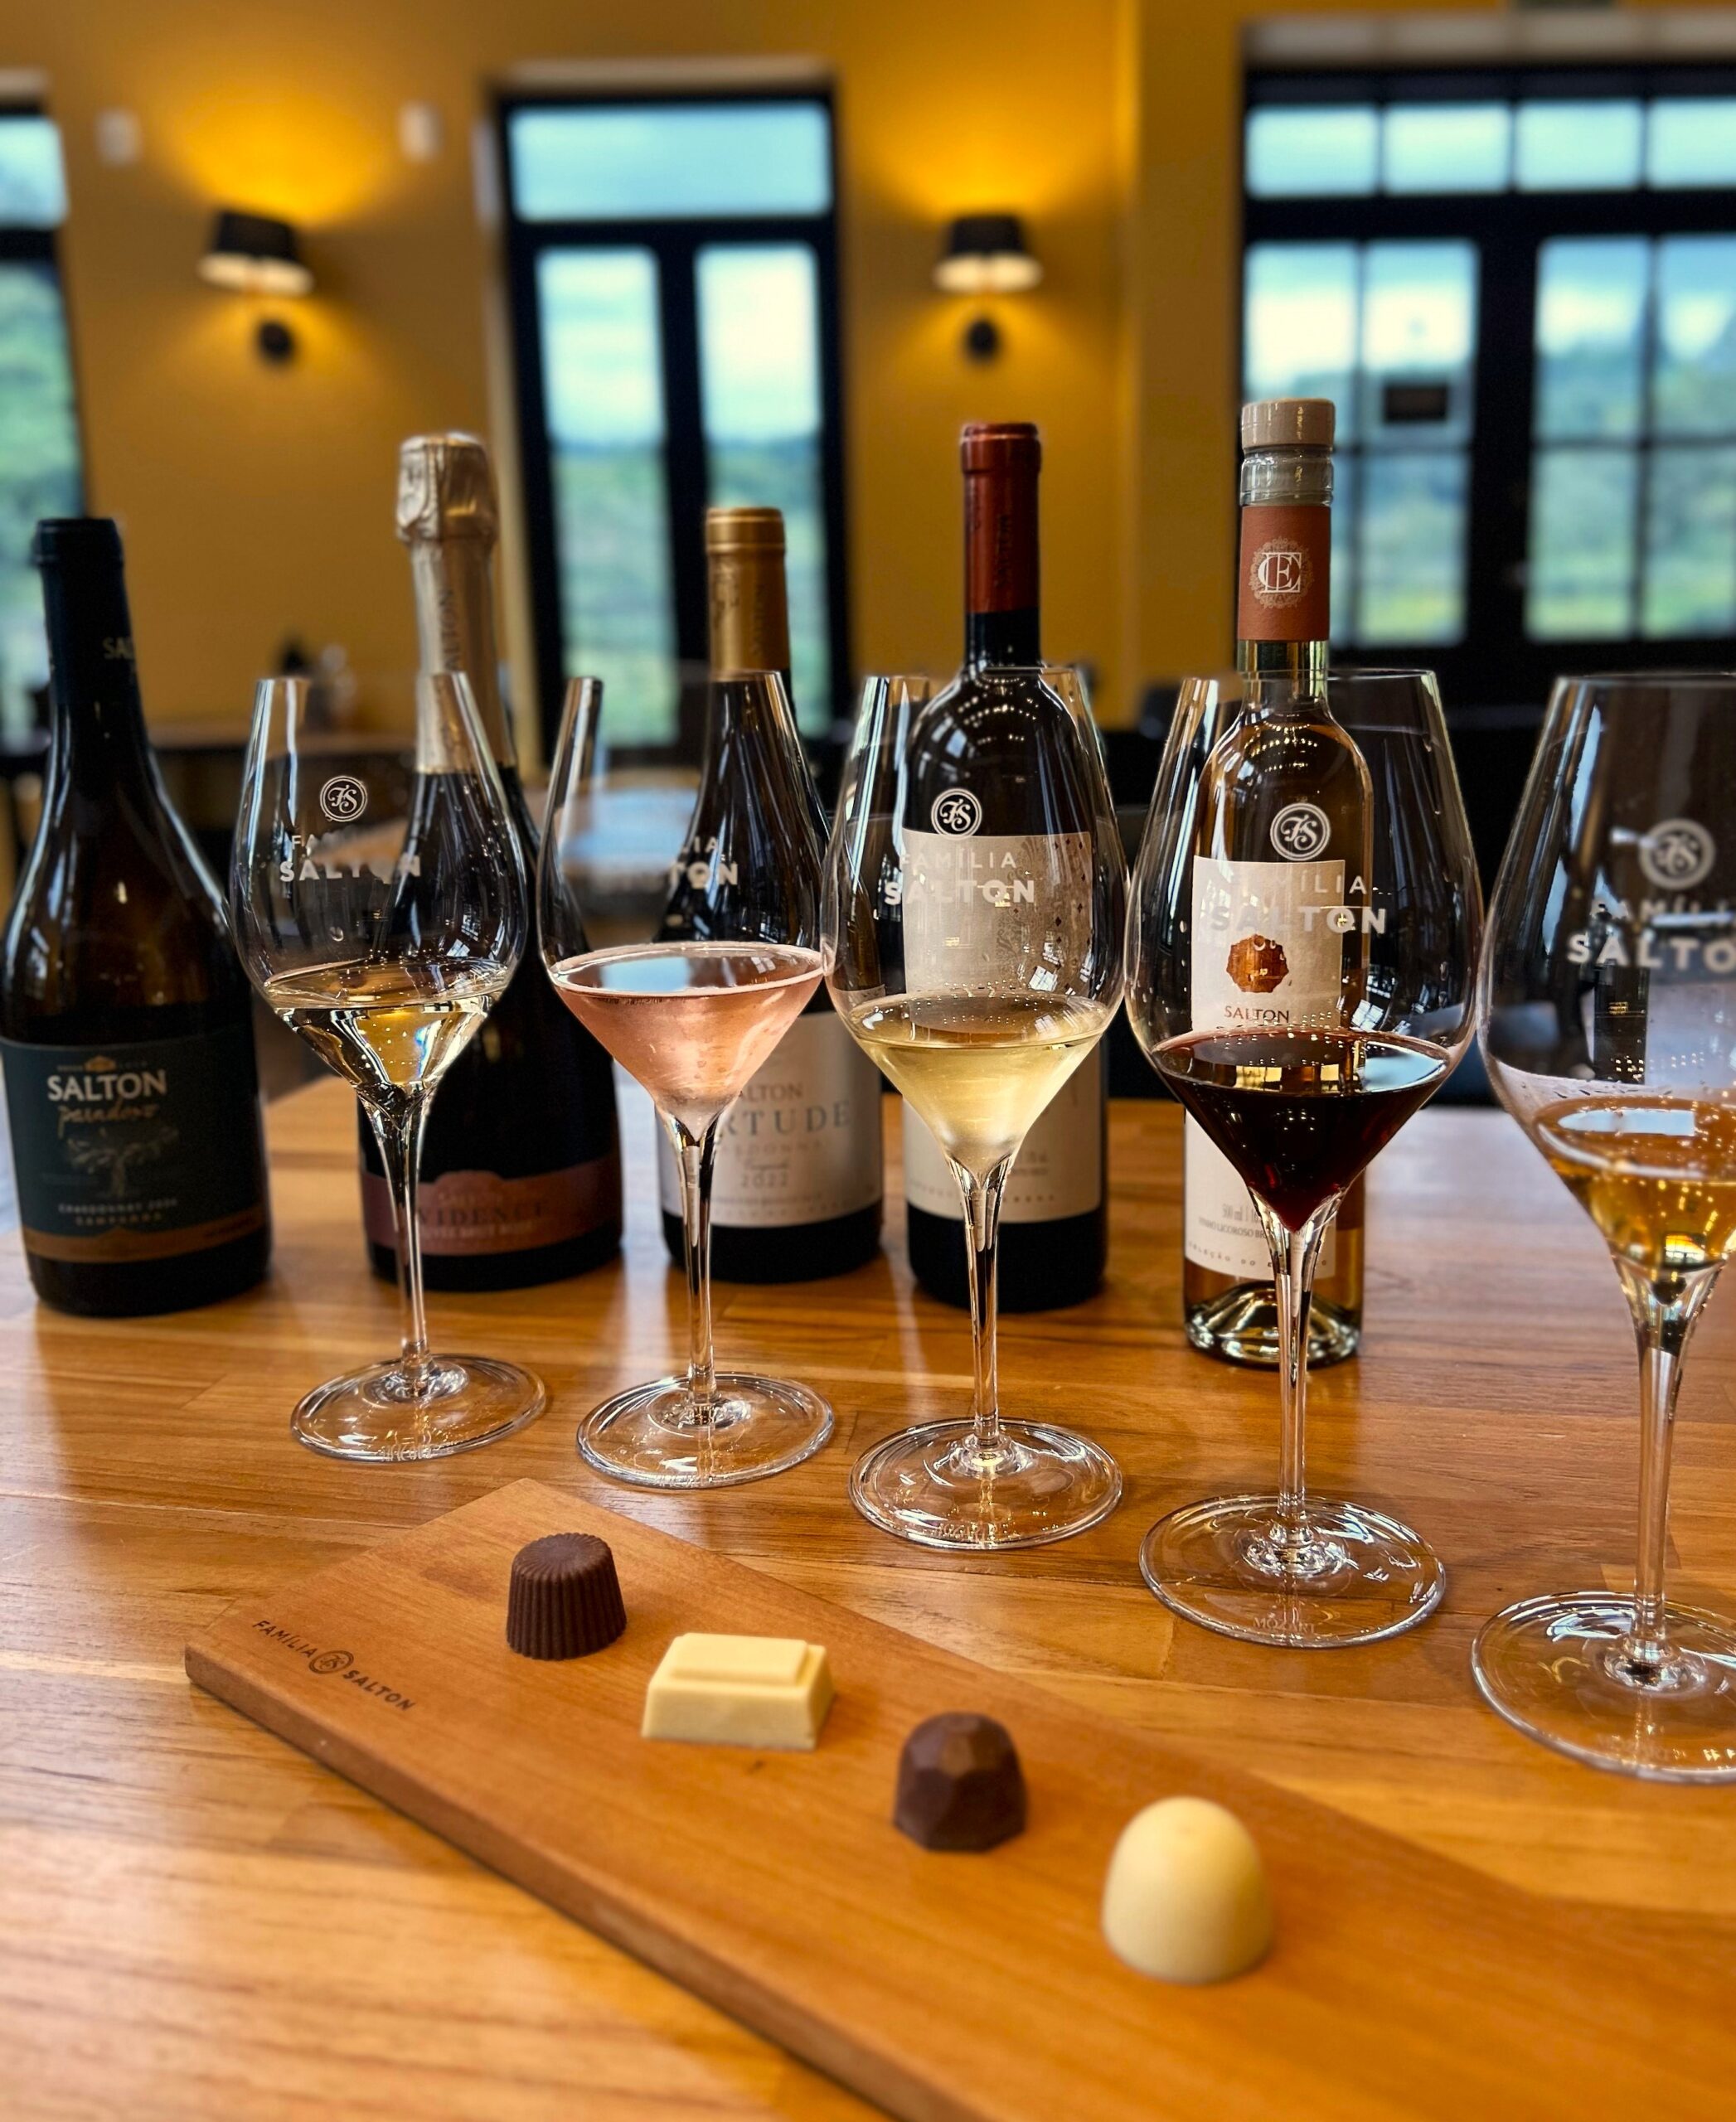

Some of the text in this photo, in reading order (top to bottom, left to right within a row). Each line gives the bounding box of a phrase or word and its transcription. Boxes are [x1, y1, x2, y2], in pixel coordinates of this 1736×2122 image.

[884, 879, 1035, 905] SALTON
[47, 1069, 167, 1102] SALTON
[252, 1621, 318, 1658] FAMÍLIA
[342, 1669, 416, 1712] SALTON
